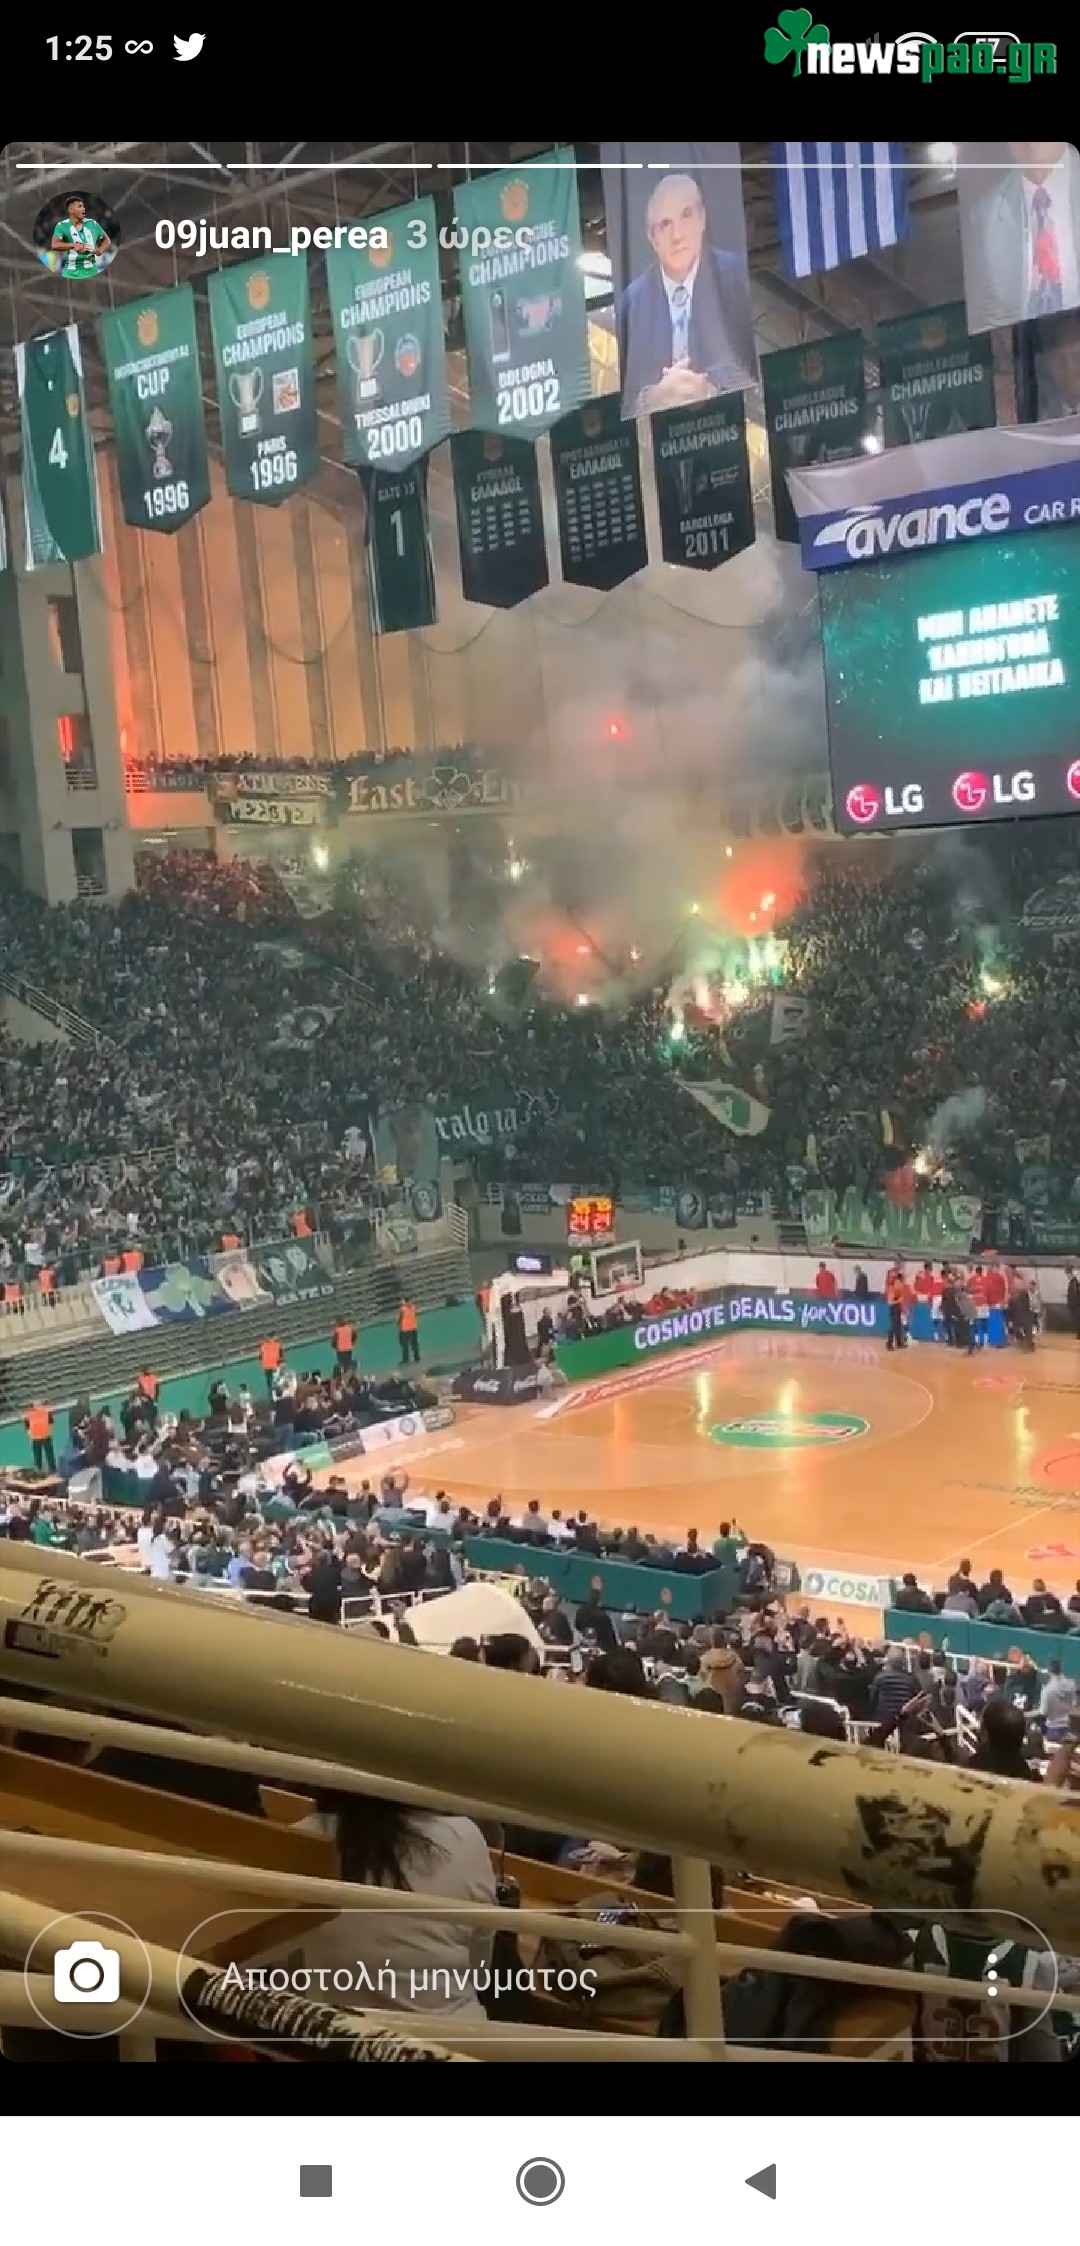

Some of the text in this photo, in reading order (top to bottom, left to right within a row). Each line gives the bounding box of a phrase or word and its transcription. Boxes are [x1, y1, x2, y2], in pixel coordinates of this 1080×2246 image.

[468, 236, 570, 287] CHAMPIONS
[340, 281, 431, 329] CHAMPIONS
[222, 322, 304, 367] CHAMPIONS
[137, 371, 170, 399] CUP
[497, 378, 561, 424] 2002
[891, 363, 985, 402] CHAMPIONS
[775, 398, 858, 433] CHAMPIONS
[49, 427, 69, 468] 4
[367, 416, 422, 460] 2000
[660, 424, 740, 458] CHAMPIONS
[250, 451, 298, 490] 1996
[143, 480, 190, 518] 1996
[390, 508, 406, 557] 1
[685, 525, 731, 558] 2011
[846, 492, 1011, 560] avance
[1023, 501, 1065, 525] CAR
[346, 774, 416, 812] East
[884, 783, 924, 815] LG
[994, 769, 1036, 803] LG
[634, 1304, 725, 1350] COSMOTE
[729, 1297, 796, 1322] DEALS
[830, 1304, 877, 1327] YOU
